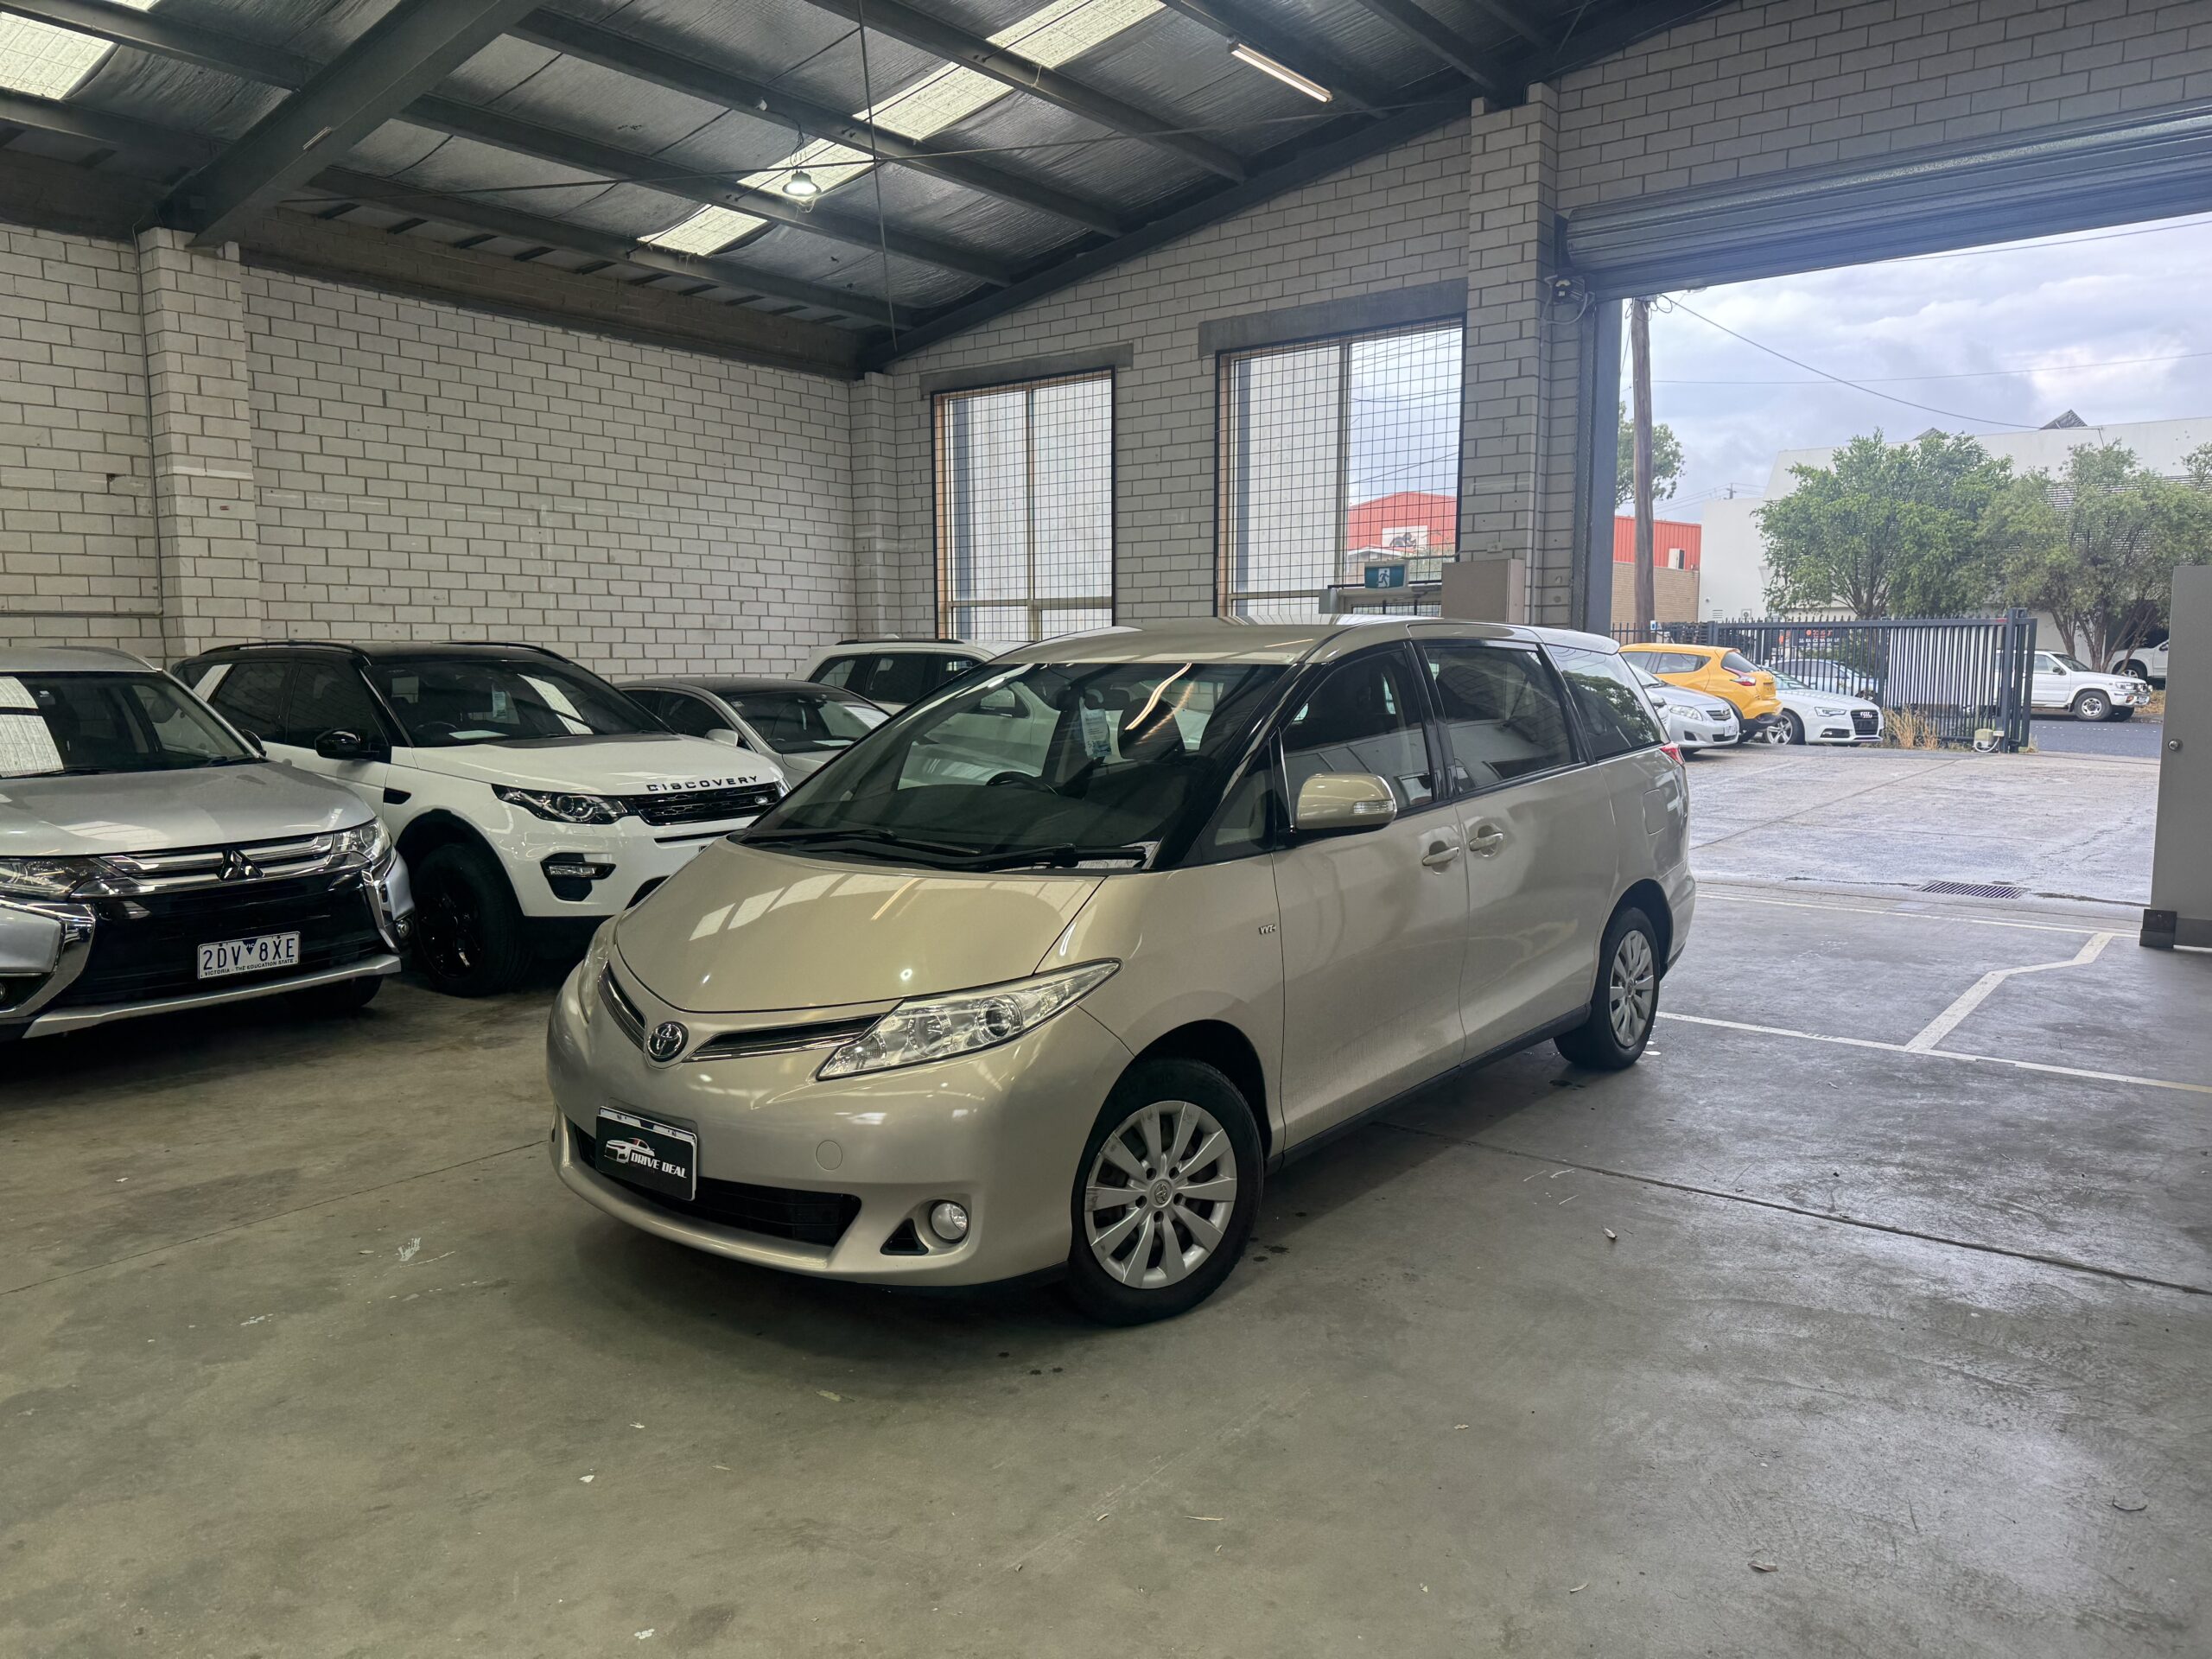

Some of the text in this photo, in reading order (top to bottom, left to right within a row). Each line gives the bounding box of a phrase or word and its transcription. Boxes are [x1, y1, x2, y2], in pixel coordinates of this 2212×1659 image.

[646, 775, 758, 791] DISCOVERY
[247, 961, 276, 970] EDUCATION
[631, 1152, 688, 1179] DRIVE DEAL
